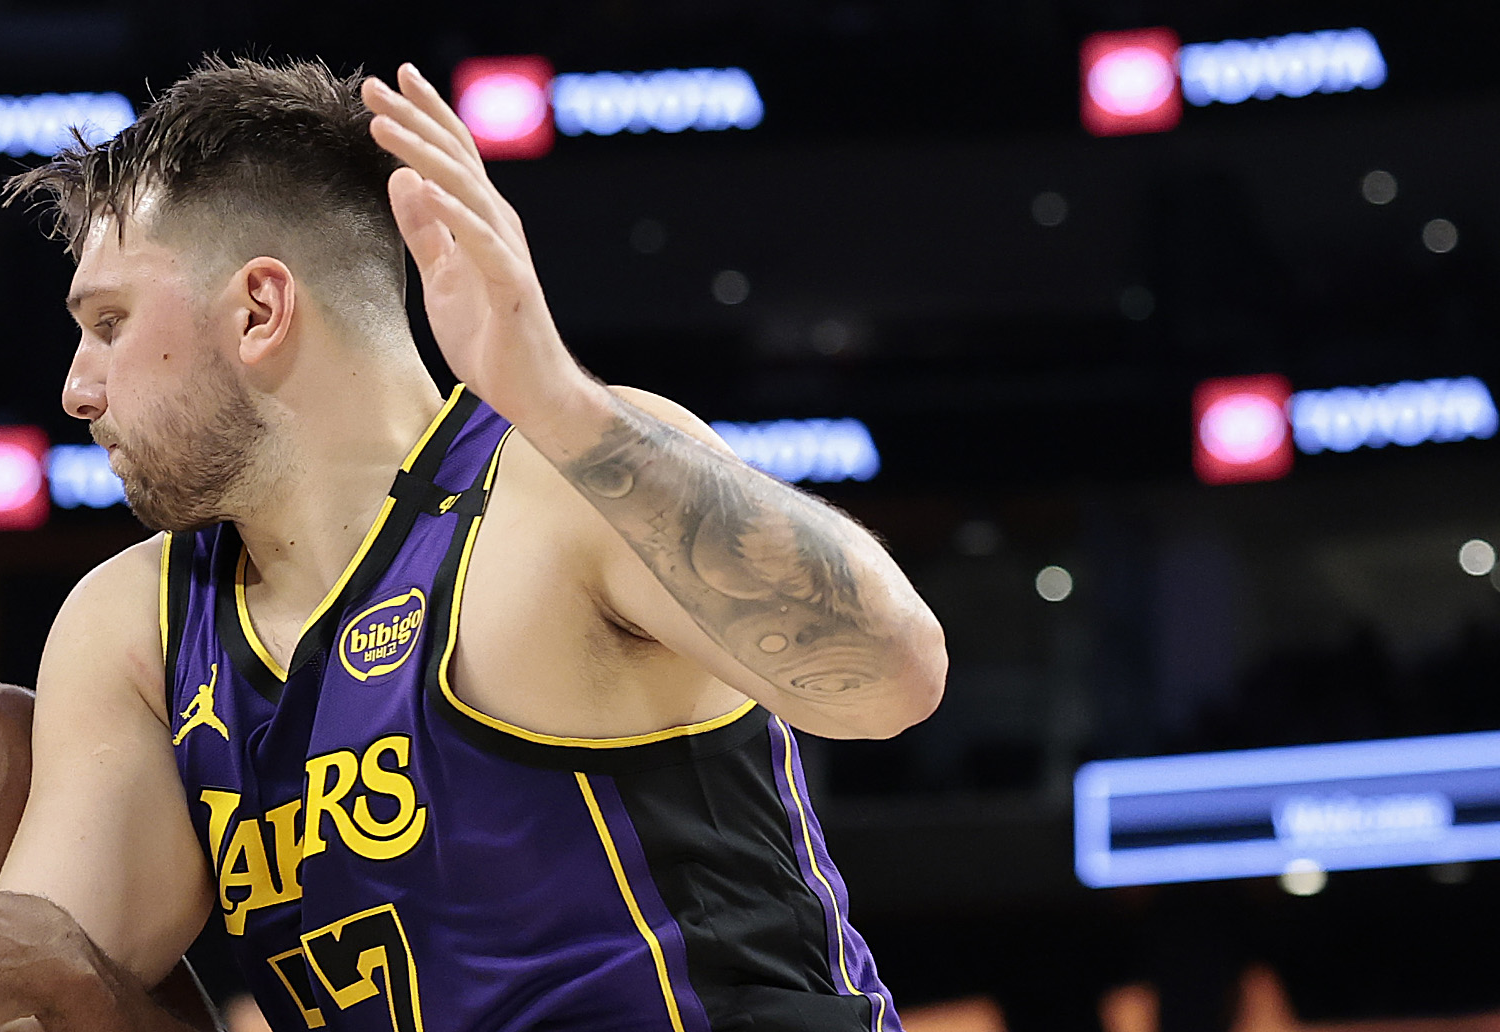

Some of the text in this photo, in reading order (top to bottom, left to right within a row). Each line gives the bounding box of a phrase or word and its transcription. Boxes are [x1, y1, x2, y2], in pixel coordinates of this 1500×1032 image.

[553, 68, 763, 134] TOYOTA
[1180, 28, 1387, 105] TOYOTA
[1290, 377, 1497, 453] TOYOTA
[350, 609, 422, 653] bibigo
